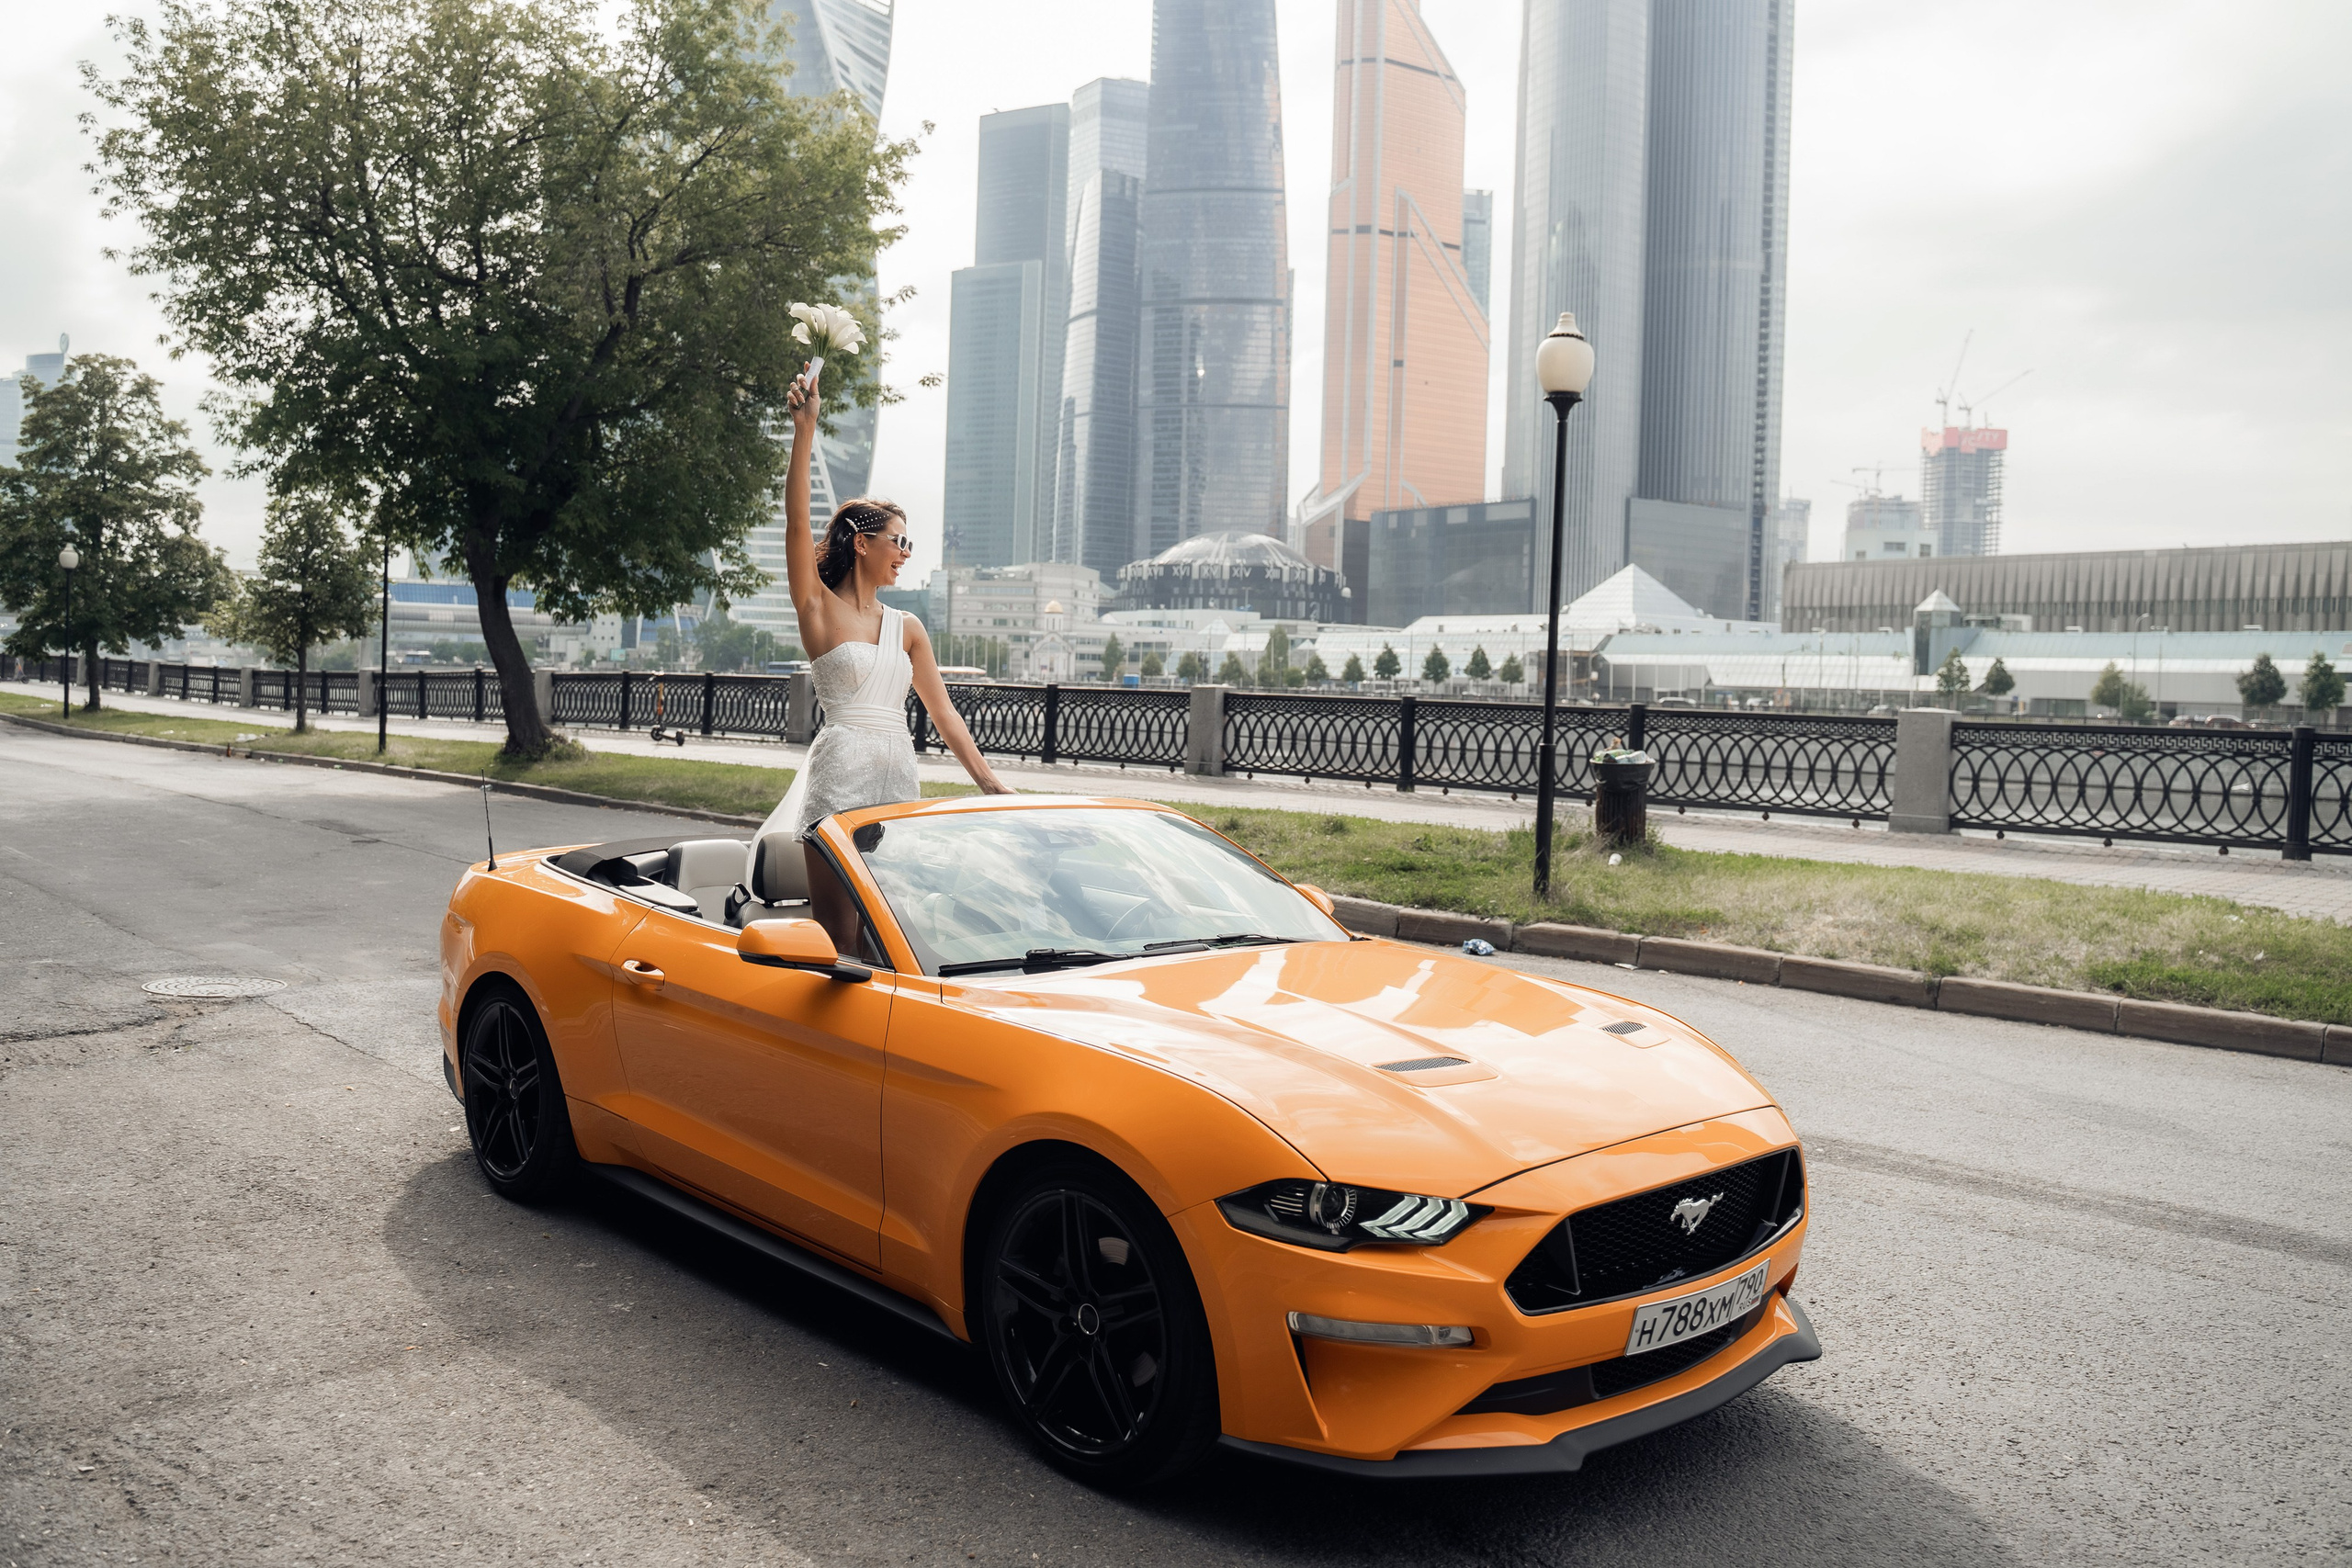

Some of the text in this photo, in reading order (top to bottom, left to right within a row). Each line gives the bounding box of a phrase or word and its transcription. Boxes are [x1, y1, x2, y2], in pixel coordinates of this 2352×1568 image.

[1232, 566, 1252, 579] XIV
[1736, 1268, 1764, 1305] 790
[1737, 1297, 1752, 1313] RUS
